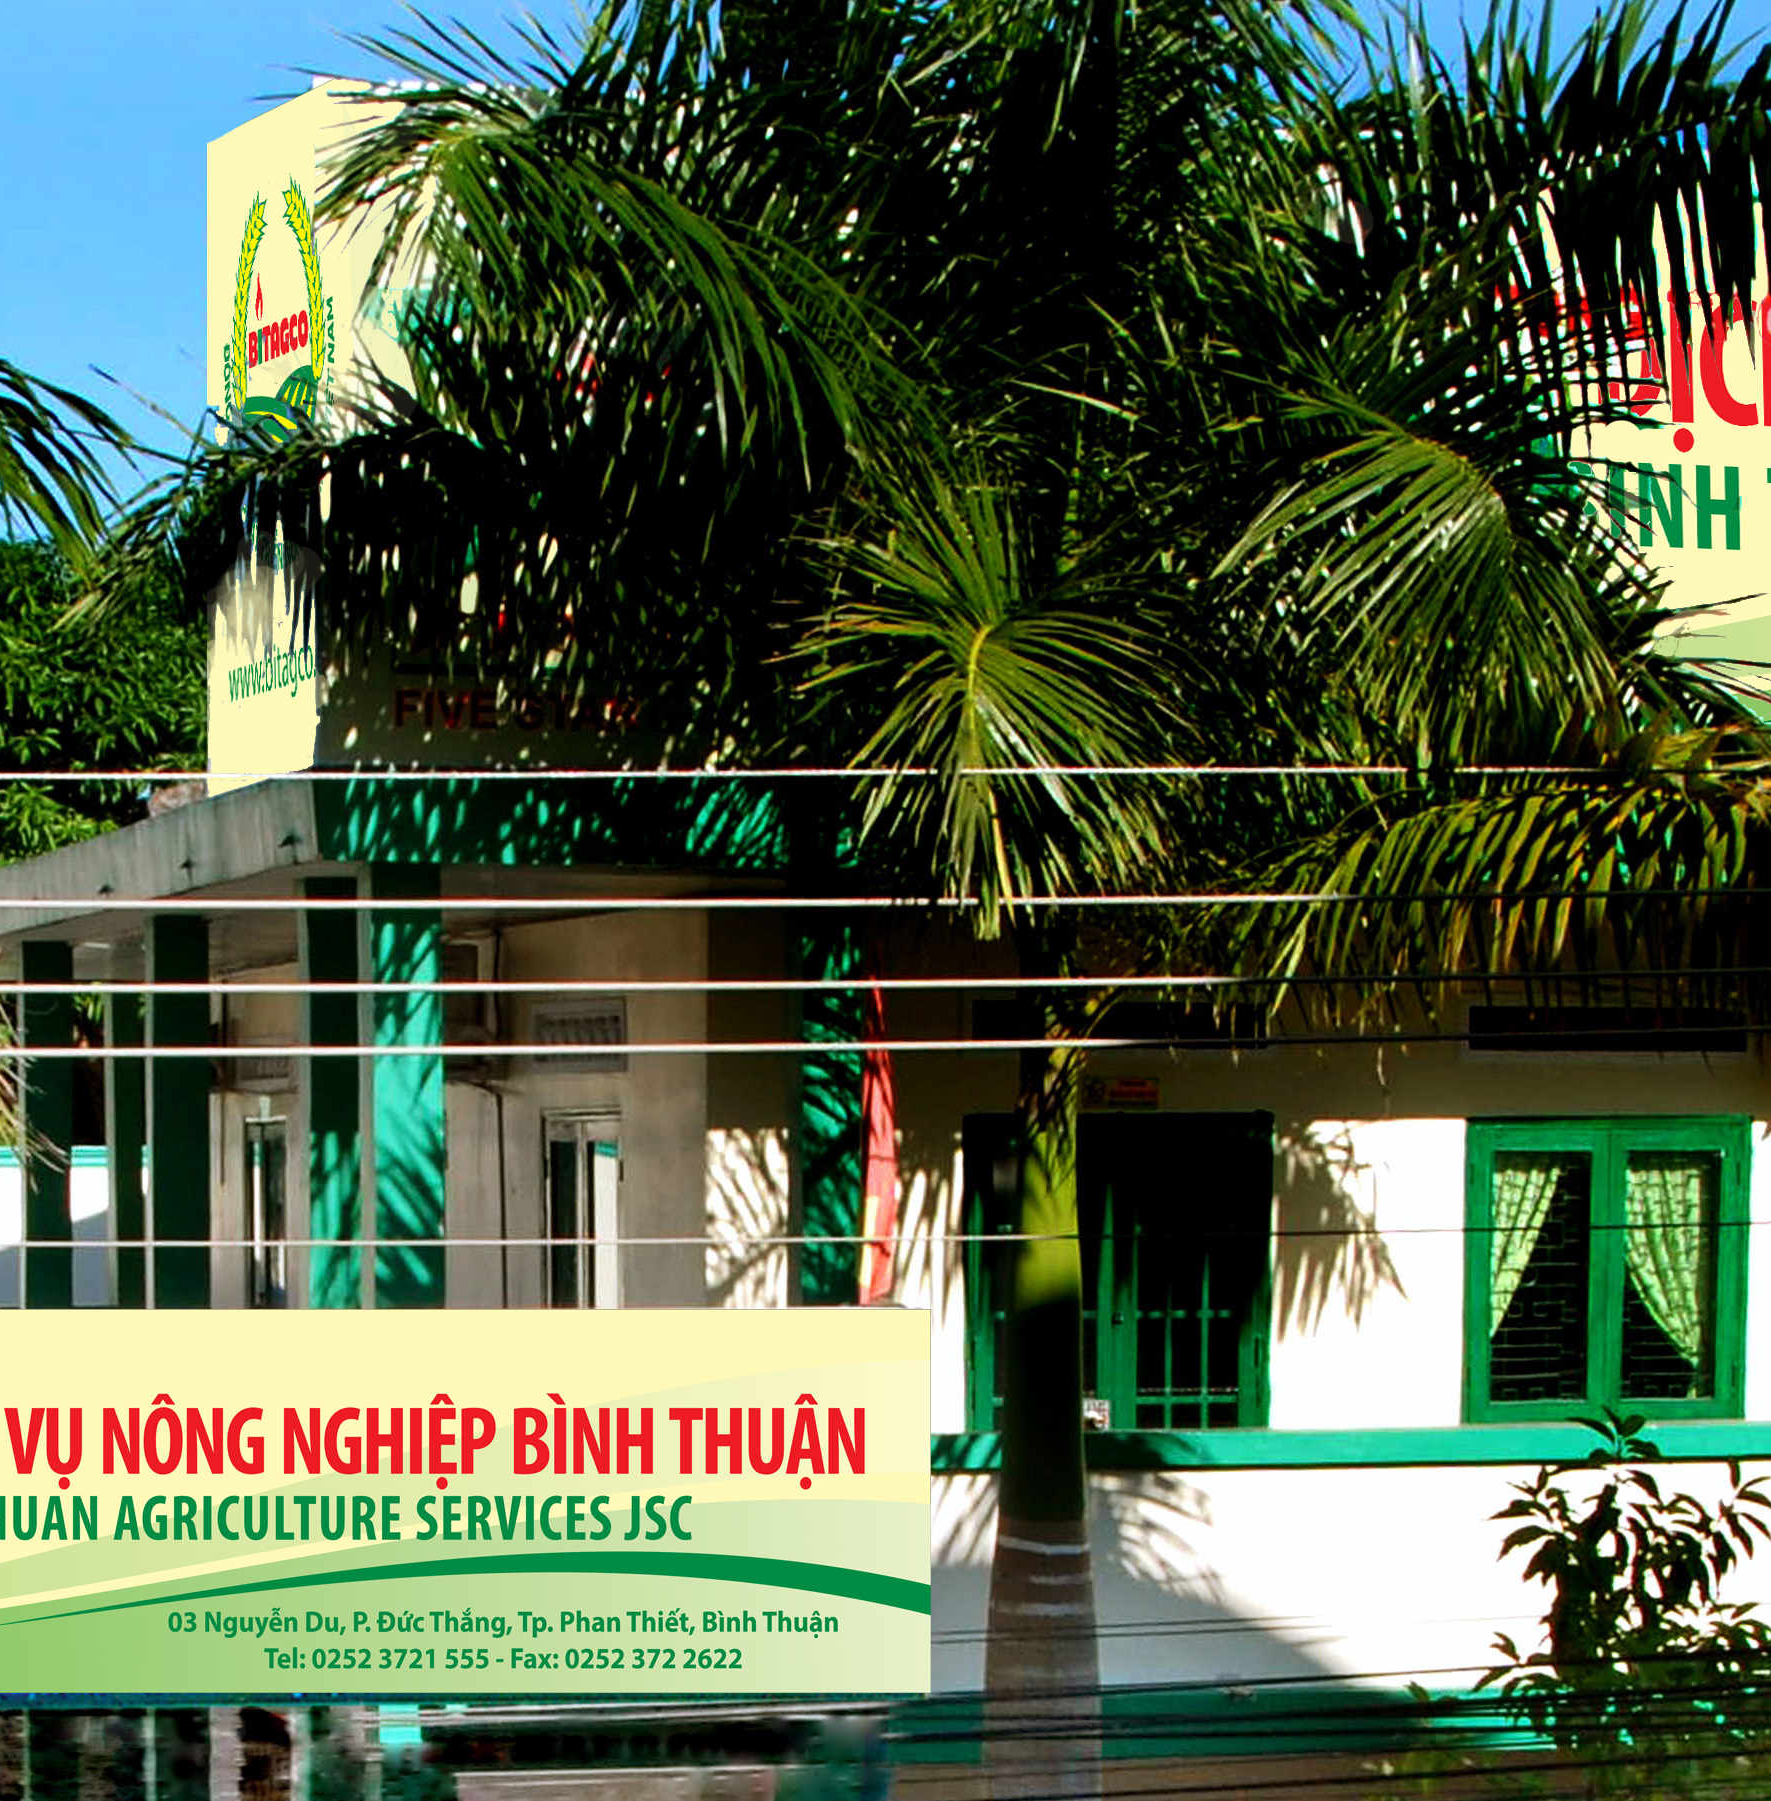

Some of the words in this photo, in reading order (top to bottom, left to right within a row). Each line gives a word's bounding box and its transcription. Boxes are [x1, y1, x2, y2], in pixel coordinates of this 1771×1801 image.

[248, 309, 309, 369] BITAGCO
[326, 296, 335, 364] NAM
[1566, 460, 1740, 550] INH
[4, 1408, 82, 1489] VỤ
[103, 1394, 264, 1474] NÔNG
[284, 1394, 496, 1489] NGHIỆP
[514, 1394, 653, 1474] BÌNH
[669, 1394, 865, 1489] THUẬN
[114, 1496, 400, 1540] AGRICULTURE
[416, 1496, 611, 1540] SERVICES
[624, 1496, 692, 1545] JSC
[168, 1612, 197, 1632] 03
[205, 1608, 297, 1638] Nguyễn
[306, 1611, 346, 1636] Du,
[354, 1611, 371, 1632] P.
[377, 1611, 424, 1632] Đức
[429, 1608, 512, 1638] Thắng,
[518, 1612, 553, 1638] Tp.
[561, 1611, 620, 1632] Phan
[627, 1608, 695, 1636] Thiết,
[703, 1611, 756, 1632] Bình
[763, 1611, 838, 1638] Thuận
[264, 1647, 305, 1669] Tel:
[312, 1648, 371, 1669] 0252
[379, 1648, 434, 1669] 3721
[445, 1648, 489, 1669] 555
[512, 1648, 558, 1669] Fax:
[565, 1648, 624, 1669] 0252
[632, 1648, 675, 1669] 372
[683, 1648, 742, 1669] 2622
